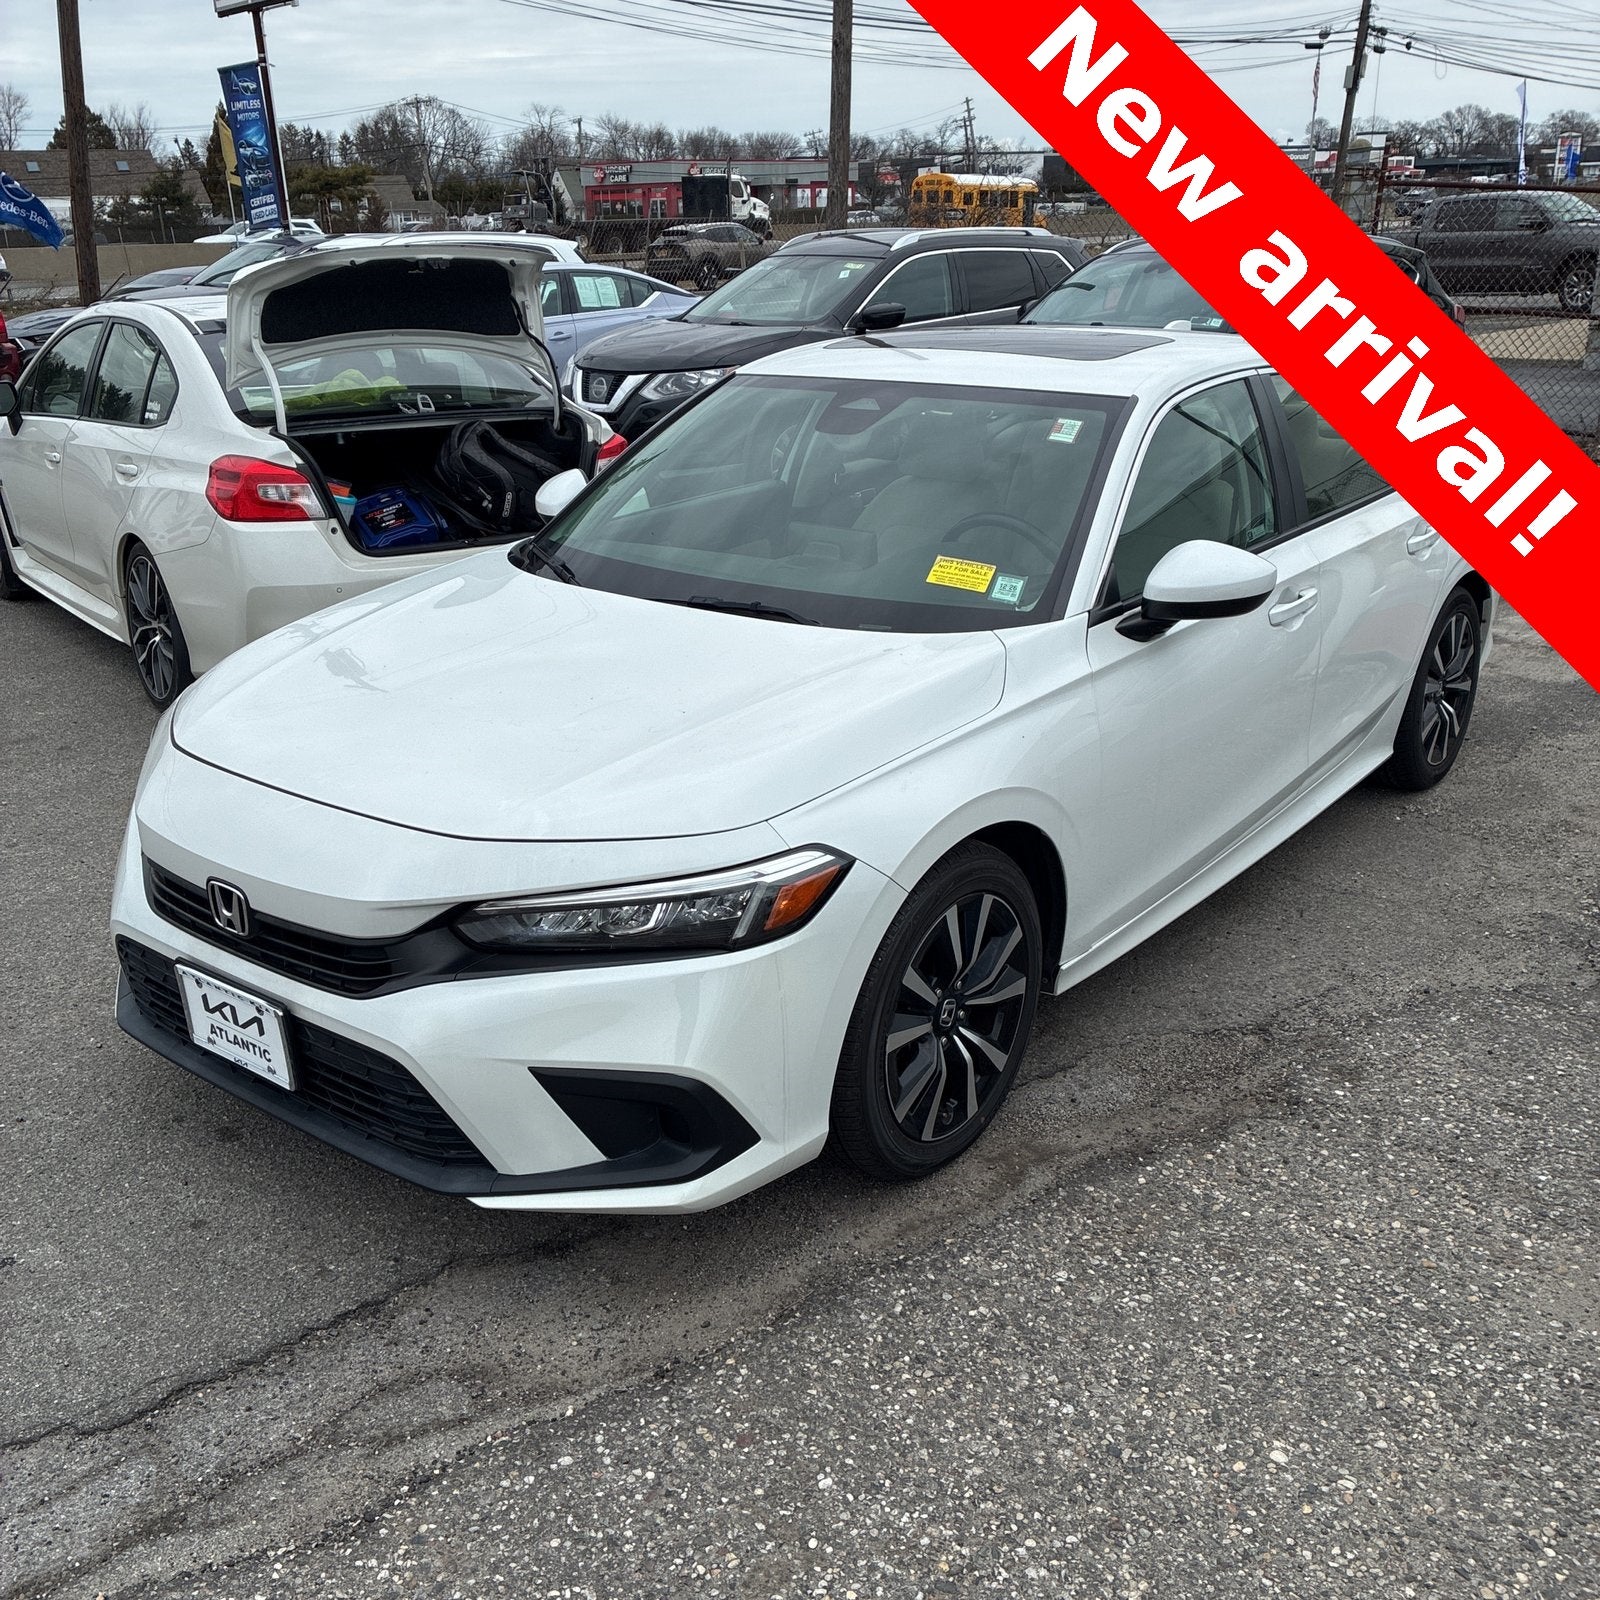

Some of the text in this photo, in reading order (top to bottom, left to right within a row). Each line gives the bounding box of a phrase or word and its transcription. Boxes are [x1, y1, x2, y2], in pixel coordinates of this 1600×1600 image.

[230, 99, 261, 111] LIMITLESS
[237, 112, 260, 121] MOTORS
[605, 165, 632, 173] URGENT
[991, 163, 1023, 174] Marine
[610, 174, 627, 182] CARE
[250, 193, 275, 207] CERTIFIED
[0, 200, 50, 230] edes-Ben
[252, 207, 277, 220] USED CARS
[937, 563, 989, 577] NOT FOR SALE
[956, 560, 984, 570] VEHICLE
[201, 992, 265, 1037] KIA
[210, 1023, 272, 1063] ATLANTIC
